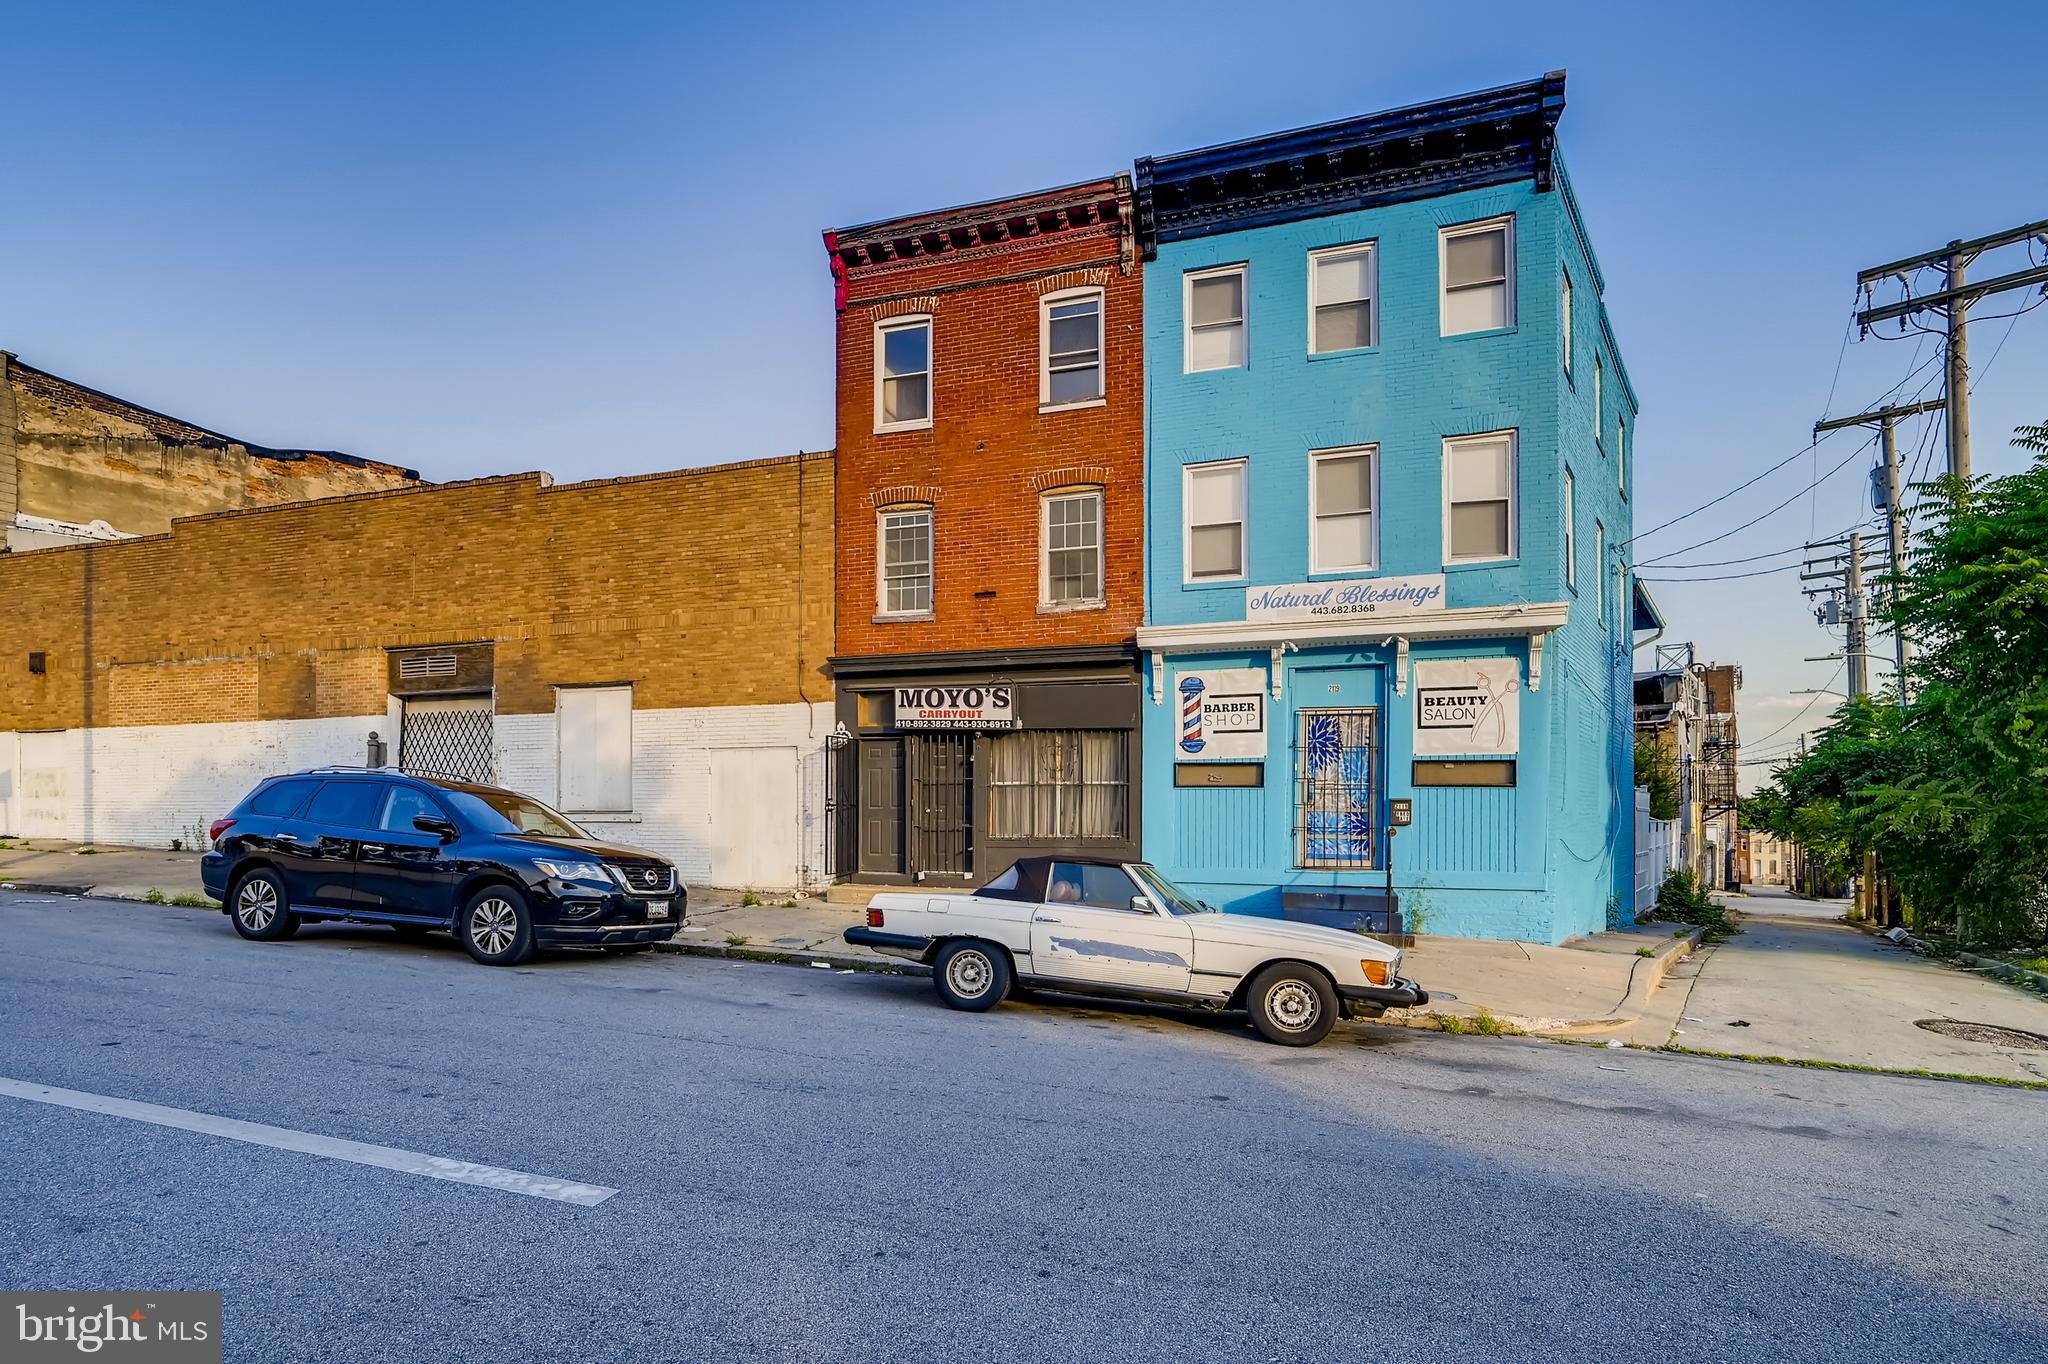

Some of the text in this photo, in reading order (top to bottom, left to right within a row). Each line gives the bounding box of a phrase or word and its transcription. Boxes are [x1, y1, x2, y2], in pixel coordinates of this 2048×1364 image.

[1251, 583, 1441, 610] Natural Blessings
[1310, 604, 1376, 615] 443.682.8368
[898, 688, 1010, 709] MOYO'S
[1424, 696, 1488, 706] BEAUTY
[1204, 703, 1256, 713] BARBER
[918, 710, 983, 718] CARRYOUT
[1204, 713, 1256, 726] SHOP
[1424, 708, 1476, 720] SALON
[896, 720, 1011, 728] 410-892-3829 443-930-6913
